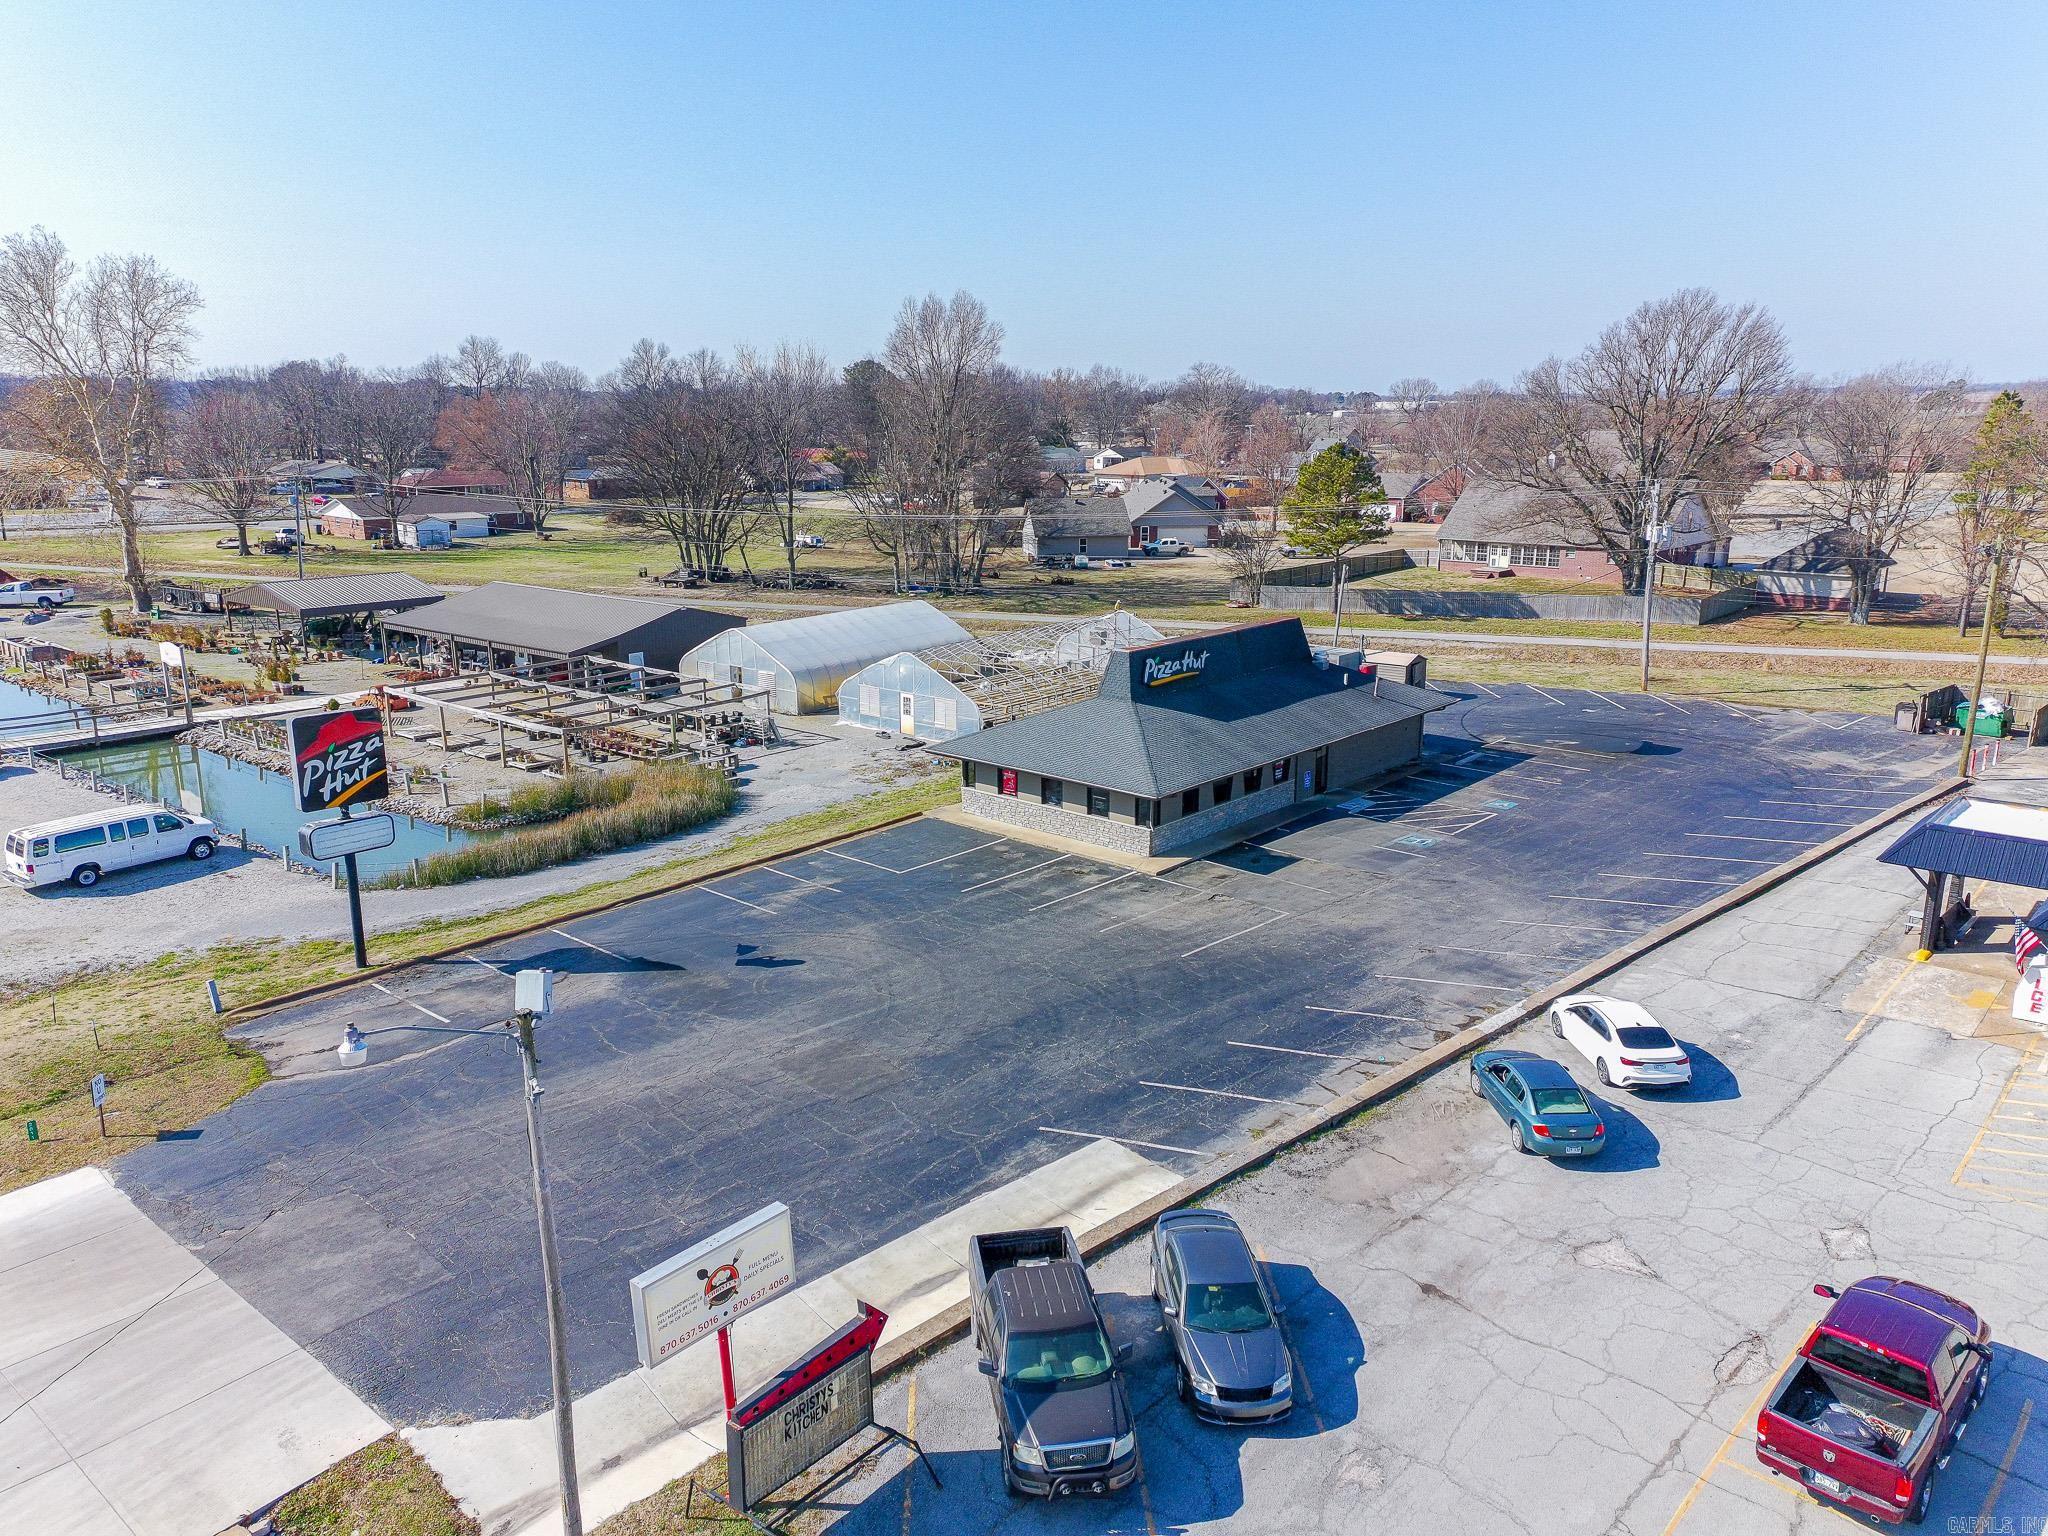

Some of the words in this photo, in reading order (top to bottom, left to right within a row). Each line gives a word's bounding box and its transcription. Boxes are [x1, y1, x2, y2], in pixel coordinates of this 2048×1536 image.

[1144, 656, 1181, 683] Pizza
[1182, 650, 1210, 672] Hut
[302, 734, 384, 798] Pizza
[319, 757, 378, 801] Hut
[2030, 978, 2044, 1013] ICE
[743, 1268, 759, 1281] DAILY
[759, 1255, 785, 1273] SPECIALS
[748, 1259, 761, 1270] FULL
[762, 1250, 779, 1263] MENU
[656, 1308, 671, 1320] FRESH
[660, 1314, 720, 1355] 870.637.5016
[732, 1273, 790, 1313] 870.637.4069
[783, 1382, 834, 1426] CHRISTYS
[783, 1402, 830, 1443] KITCHEN
